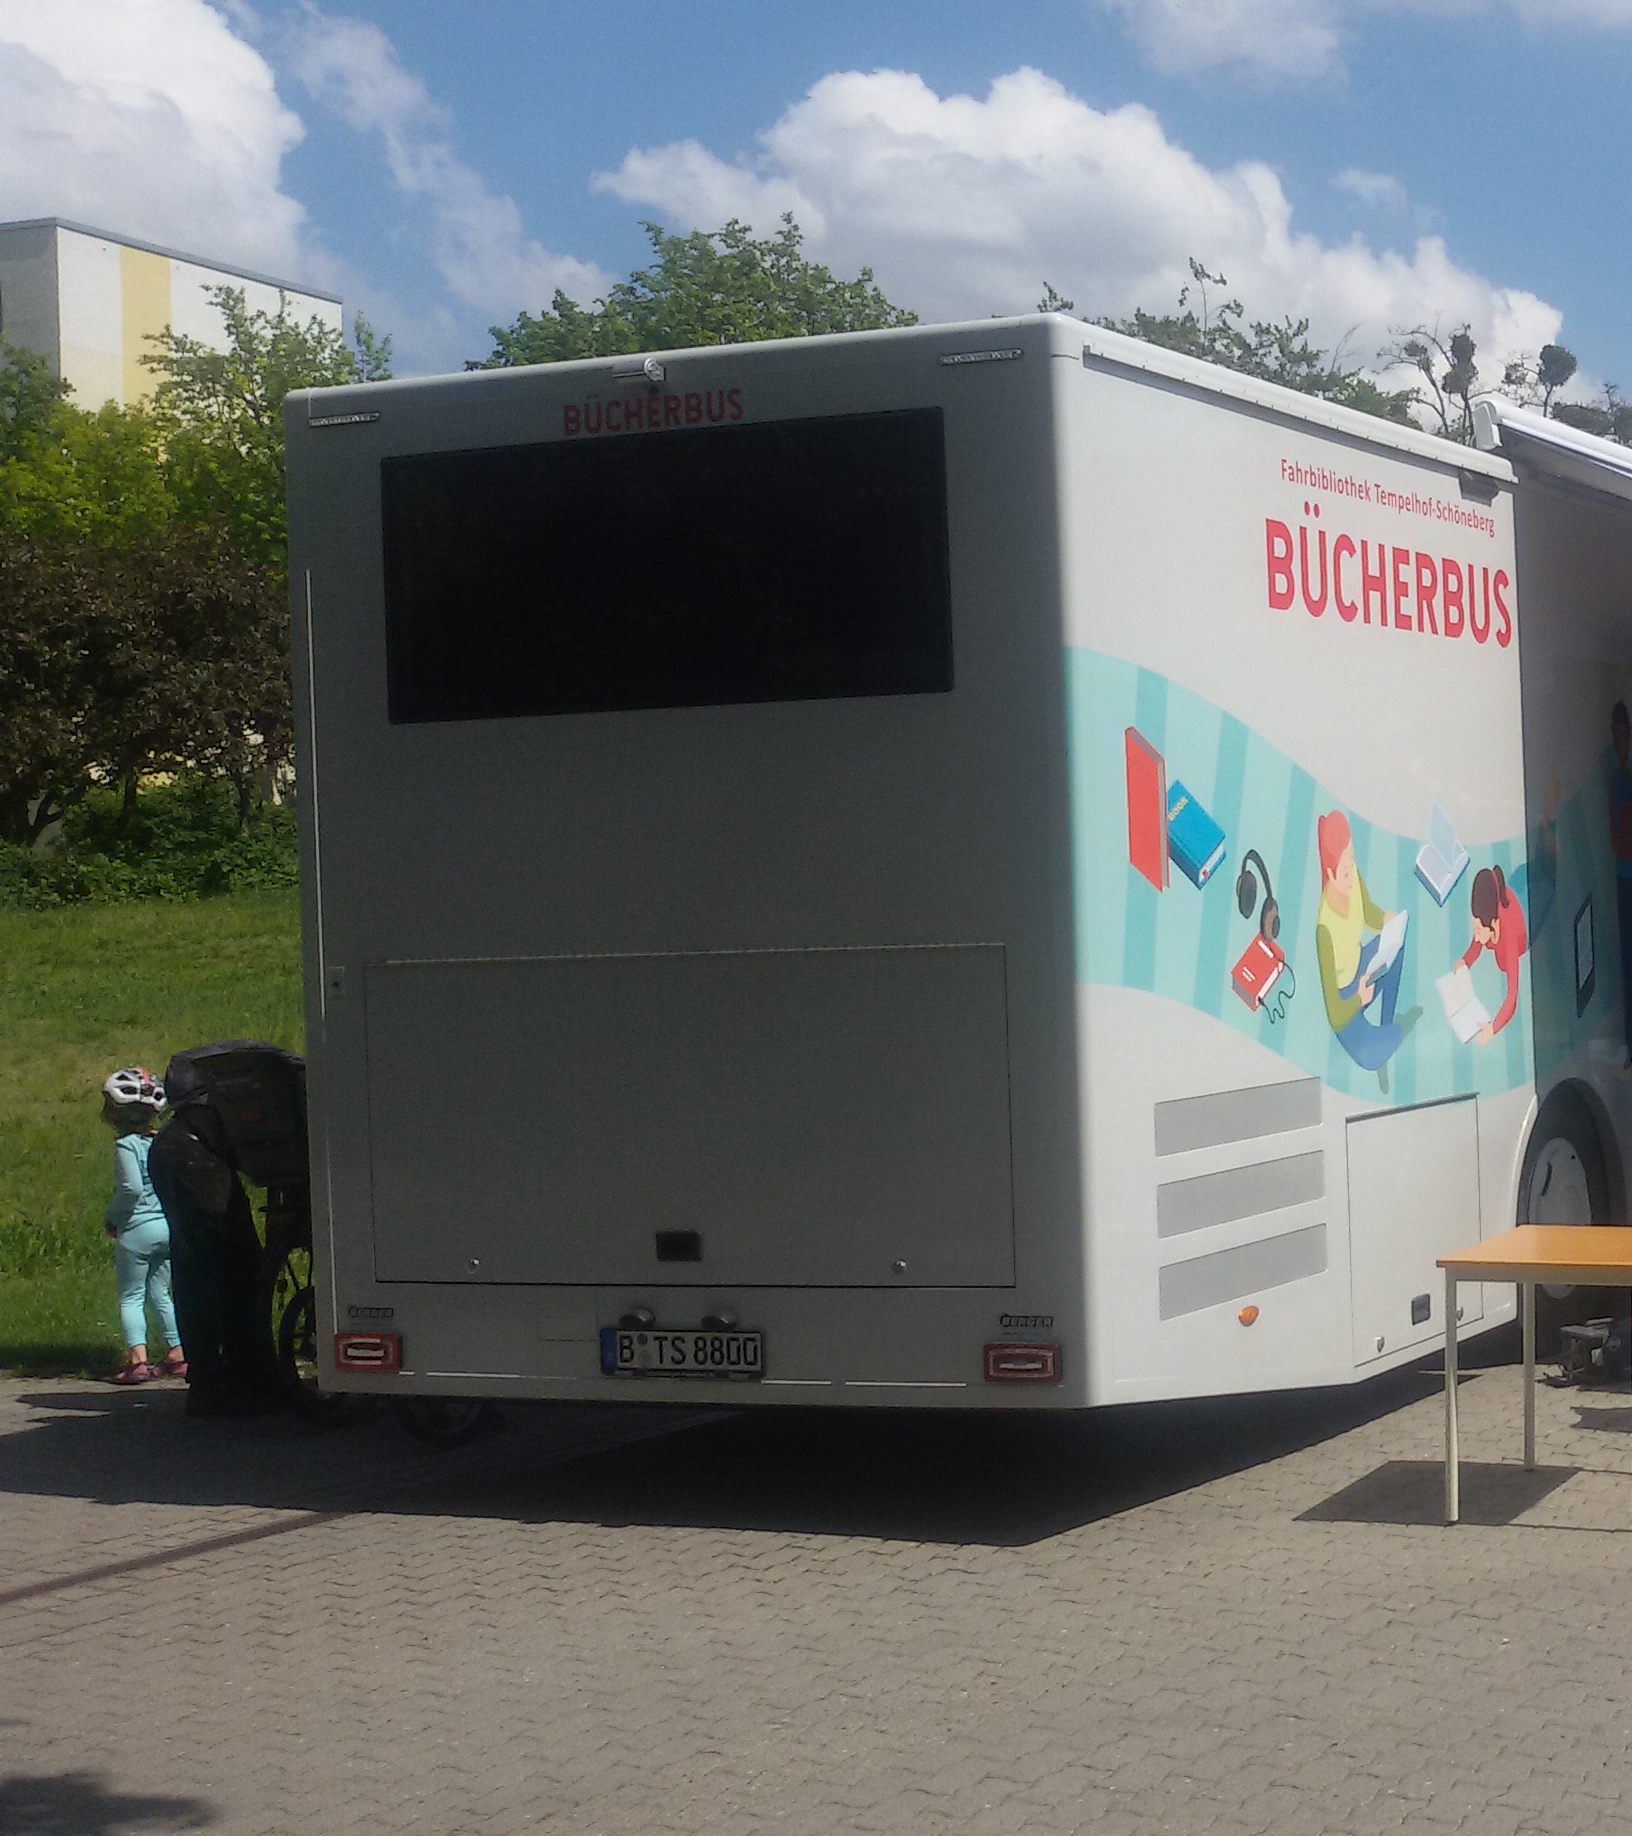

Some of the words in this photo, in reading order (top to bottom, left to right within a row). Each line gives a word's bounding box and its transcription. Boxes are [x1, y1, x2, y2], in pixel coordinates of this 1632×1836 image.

[563, 387, 744, 436] BÜCHERBUS
[1281, 458, 1371, 502] Fahrbibliothek
[1374, 483, 1495, 538] Tempelhof-Schöneberg
[1265, 500, 1512, 649] BÜCHERBUS
[619, 1335, 635, 1364] B
[653, 1335, 686, 1366] TS
[693, 1336, 759, 1367] 8800
